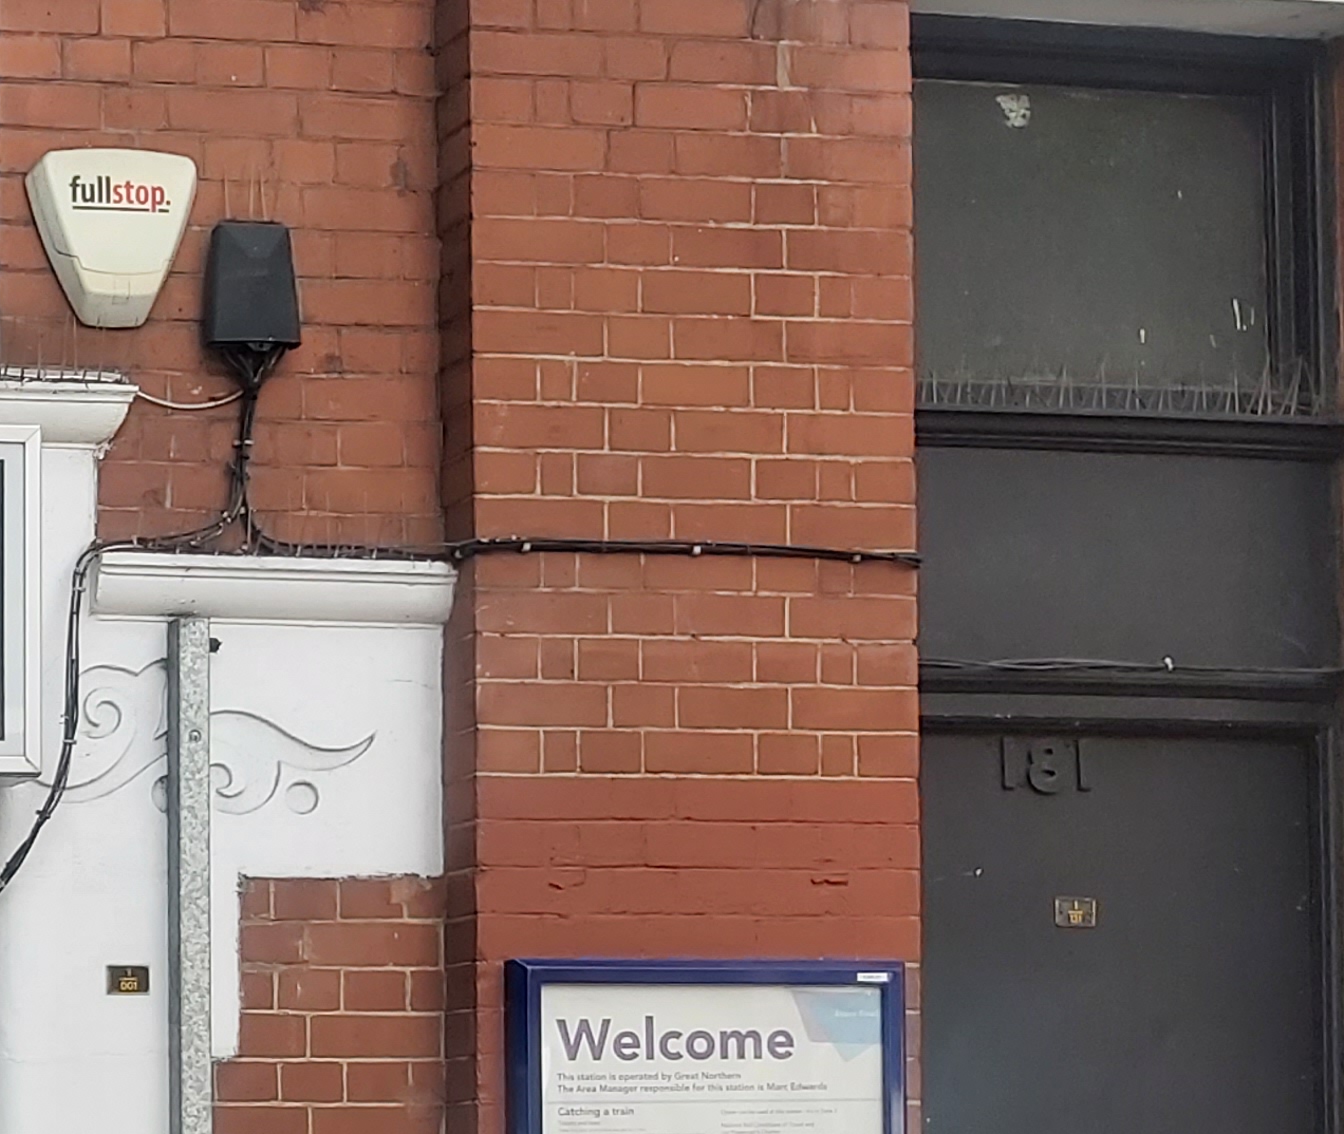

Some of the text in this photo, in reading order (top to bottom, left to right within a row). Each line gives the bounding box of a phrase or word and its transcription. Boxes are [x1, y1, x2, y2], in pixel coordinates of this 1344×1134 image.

[999, 736, 1092, 797] 181
[555, 1015, 796, 1062] Welcome
[557, 1072, 575, 1081] This
[577, 1072, 607, 1081] station
[618, 1072, 659, 1083] operated
[660, 1072, 672, 1083] by
[674, 1071, 699, 1080] Great
[701, 1071, 742, 1080] Northern
[557, 1084, 574, 1093] The
[575, 1084, 597, 1094] Area
[599, 1084, 637, 1095] Manager
[639, 1083, 690, 1094] responsible
[692, 1083, 705, 1092] for
[707, 1083, 723, 1091] this
[725, 1083, 755, 1092] station
[557, 1107, 600, 1118] Catching
[612, 1107, 634, 1116] train
